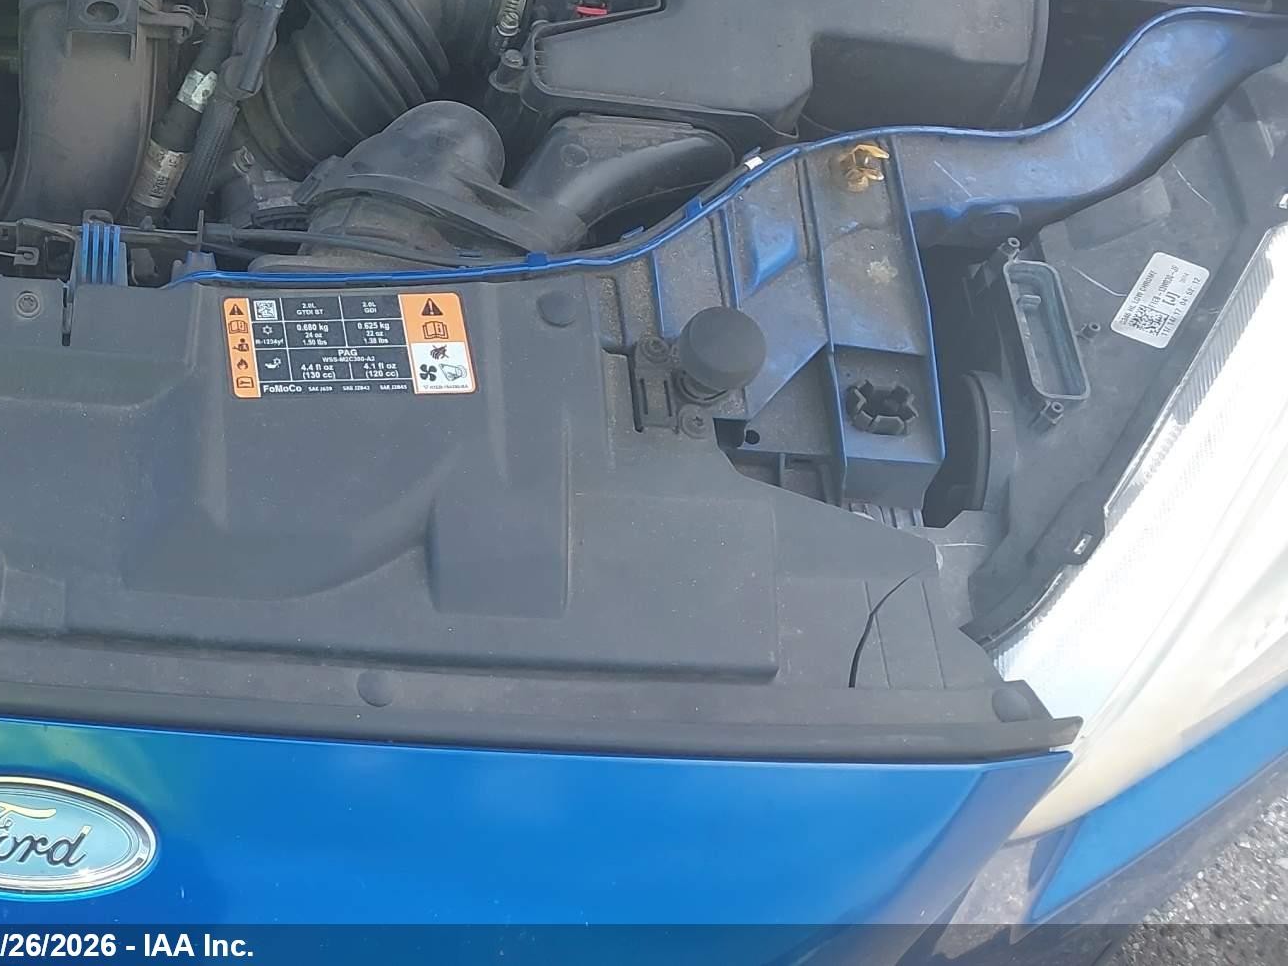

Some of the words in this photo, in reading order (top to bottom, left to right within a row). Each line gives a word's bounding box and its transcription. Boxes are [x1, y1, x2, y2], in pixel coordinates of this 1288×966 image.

[318, 323, 329, 333] kg
[357, 322, 378, 330] 0.625
[379, 321, 390, 332] kg
[337, 349, 358, 357] PAG
[315, 363, 322, 371] fl
[378, 362, 385, 370] fl
[302, 371, 321, 380] (130
[322, 371, 336, 380] cc)
[365, 369, 384, 378] (120
[385, 369, 399, 378] cc)
[262, 384, 303, 393] FoMoCo
